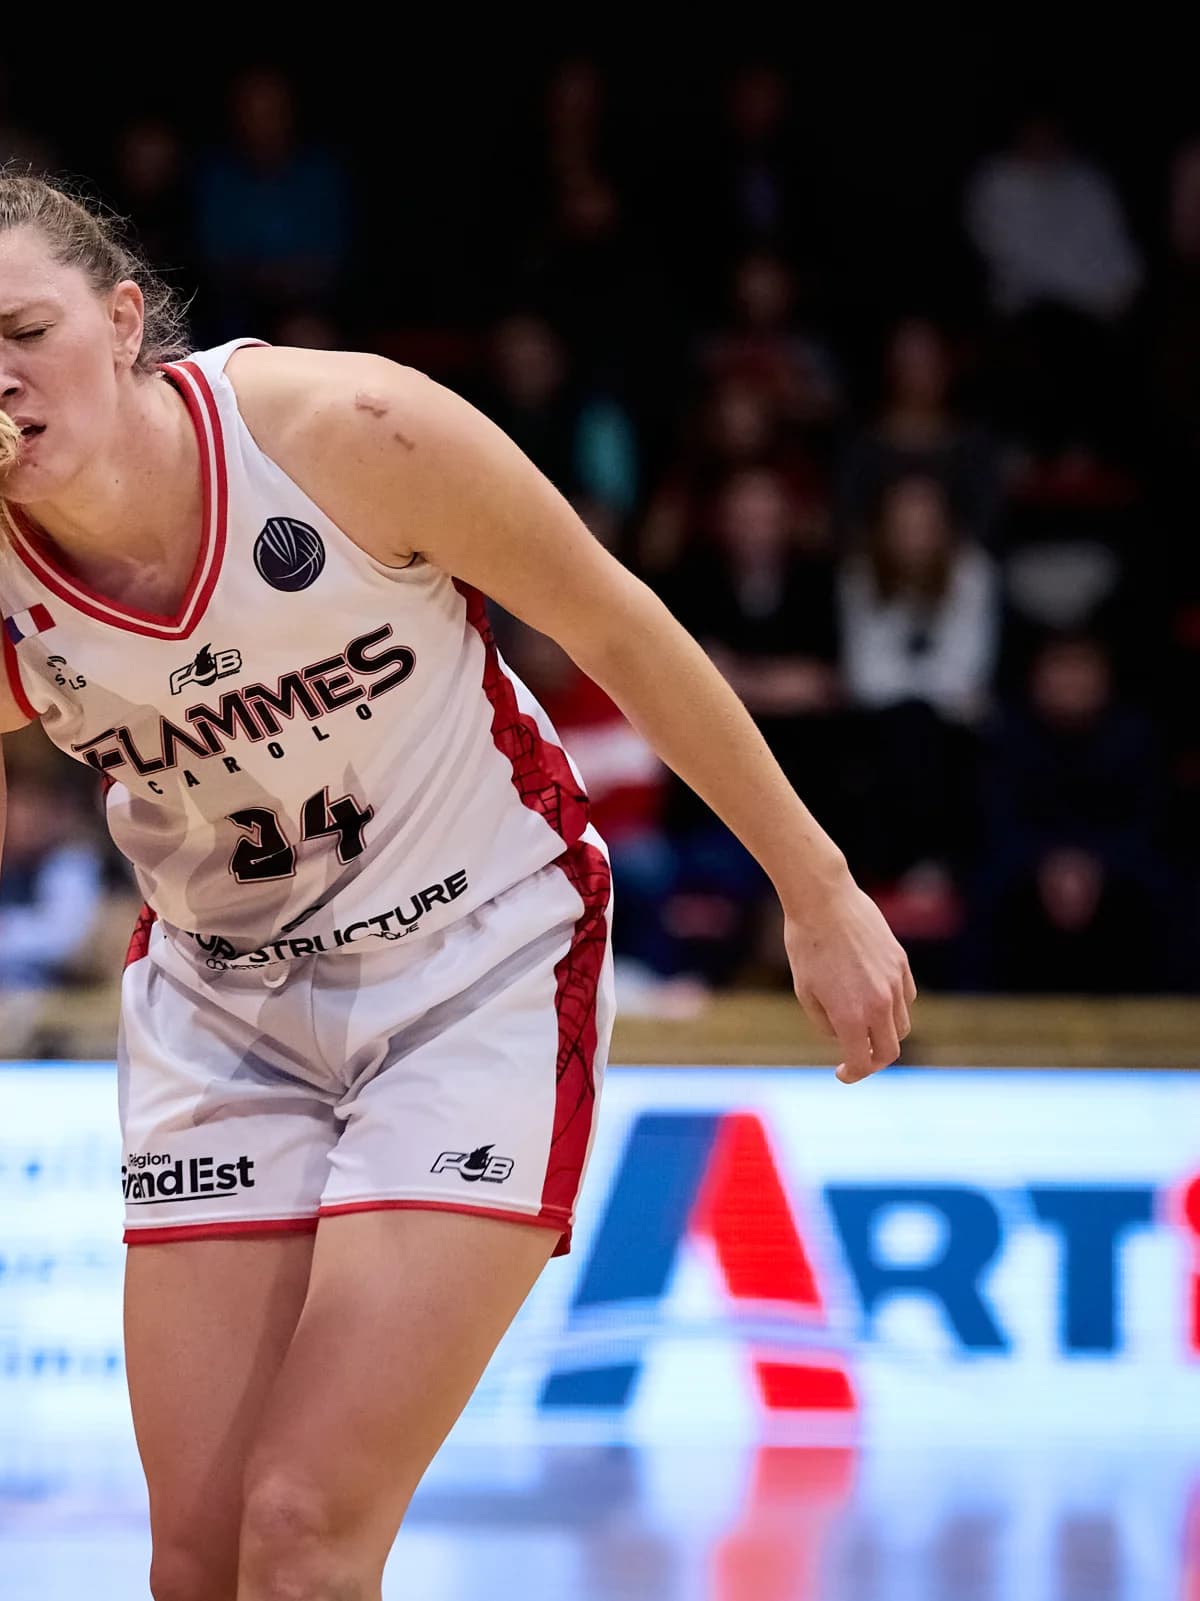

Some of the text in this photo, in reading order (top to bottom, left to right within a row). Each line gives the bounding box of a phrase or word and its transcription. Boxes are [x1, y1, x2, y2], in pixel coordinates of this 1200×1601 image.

[71, 623, 417, 776] FLAMMES
[147, 703, 373, 795] CAROLO
[224, 785, 375, 884] 24
[535, 1110, 1200, 1411] ART
